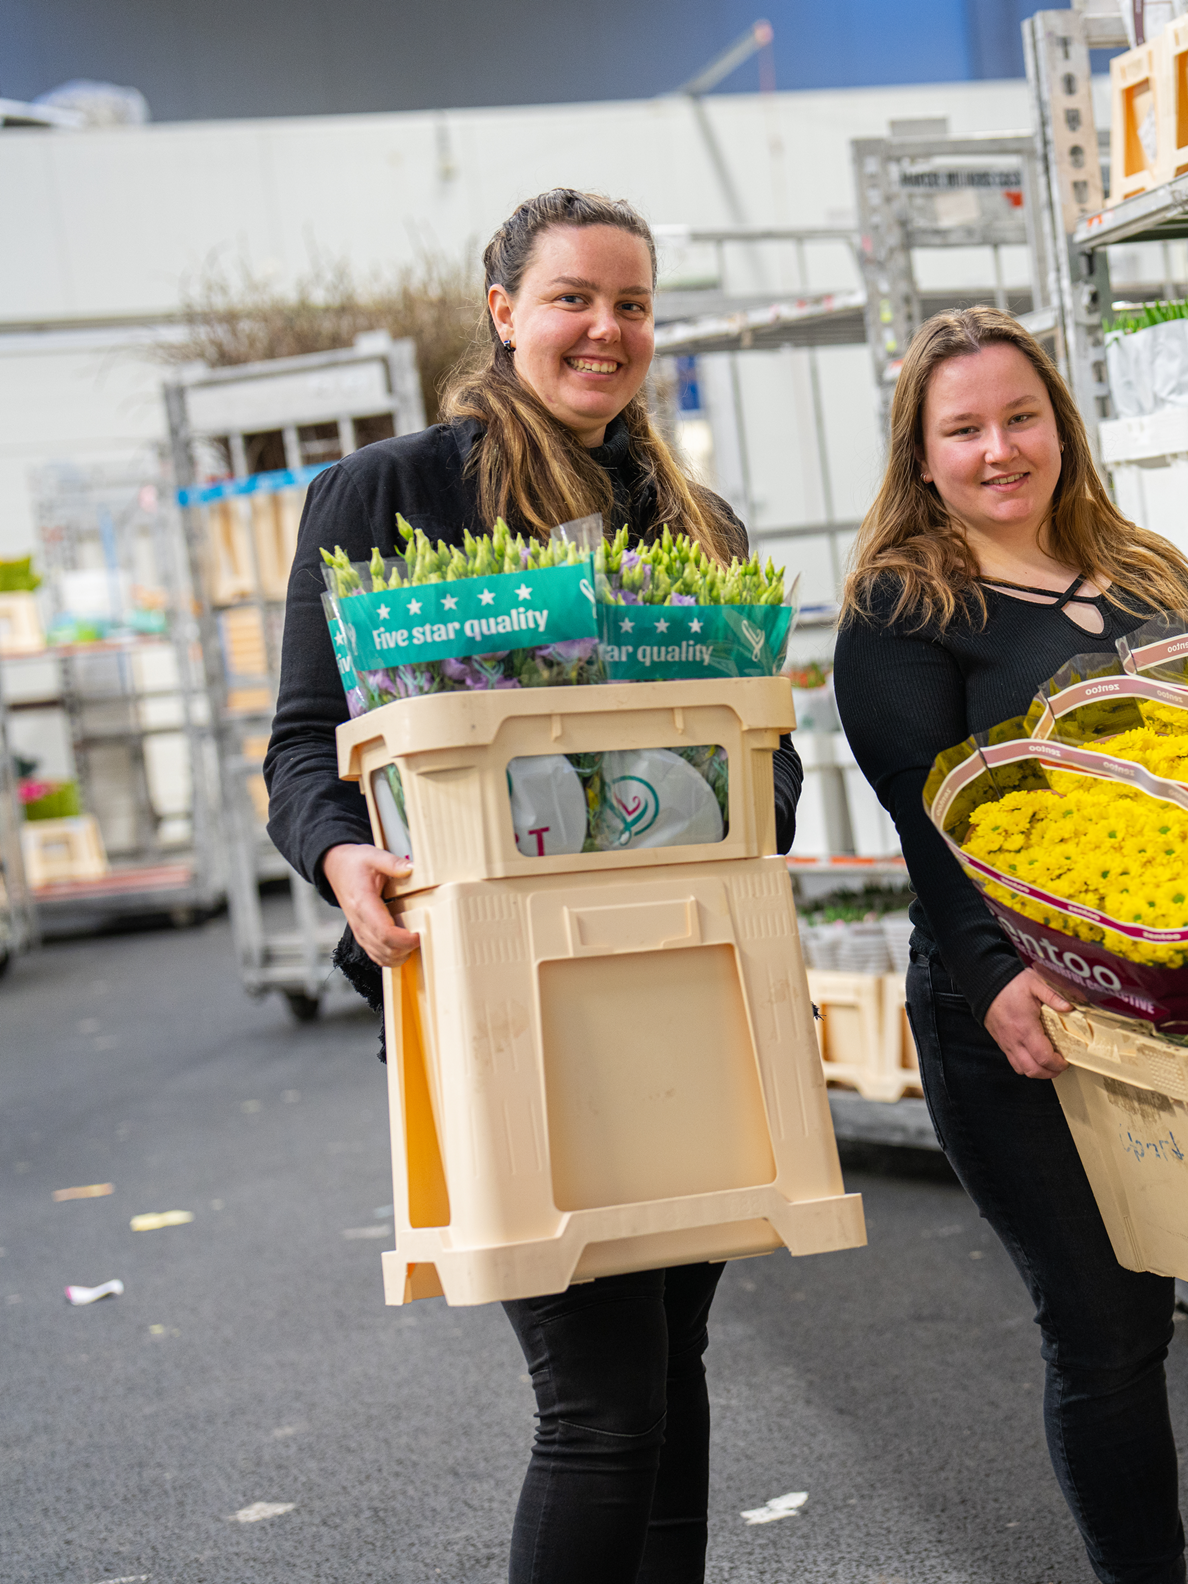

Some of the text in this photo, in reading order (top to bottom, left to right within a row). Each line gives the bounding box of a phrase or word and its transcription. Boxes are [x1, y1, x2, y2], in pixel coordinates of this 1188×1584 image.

[372, 606, 549, 650] Five star quality
[637, 639, 714, 667] quality
[990, 908, 1122, 991] entoo
